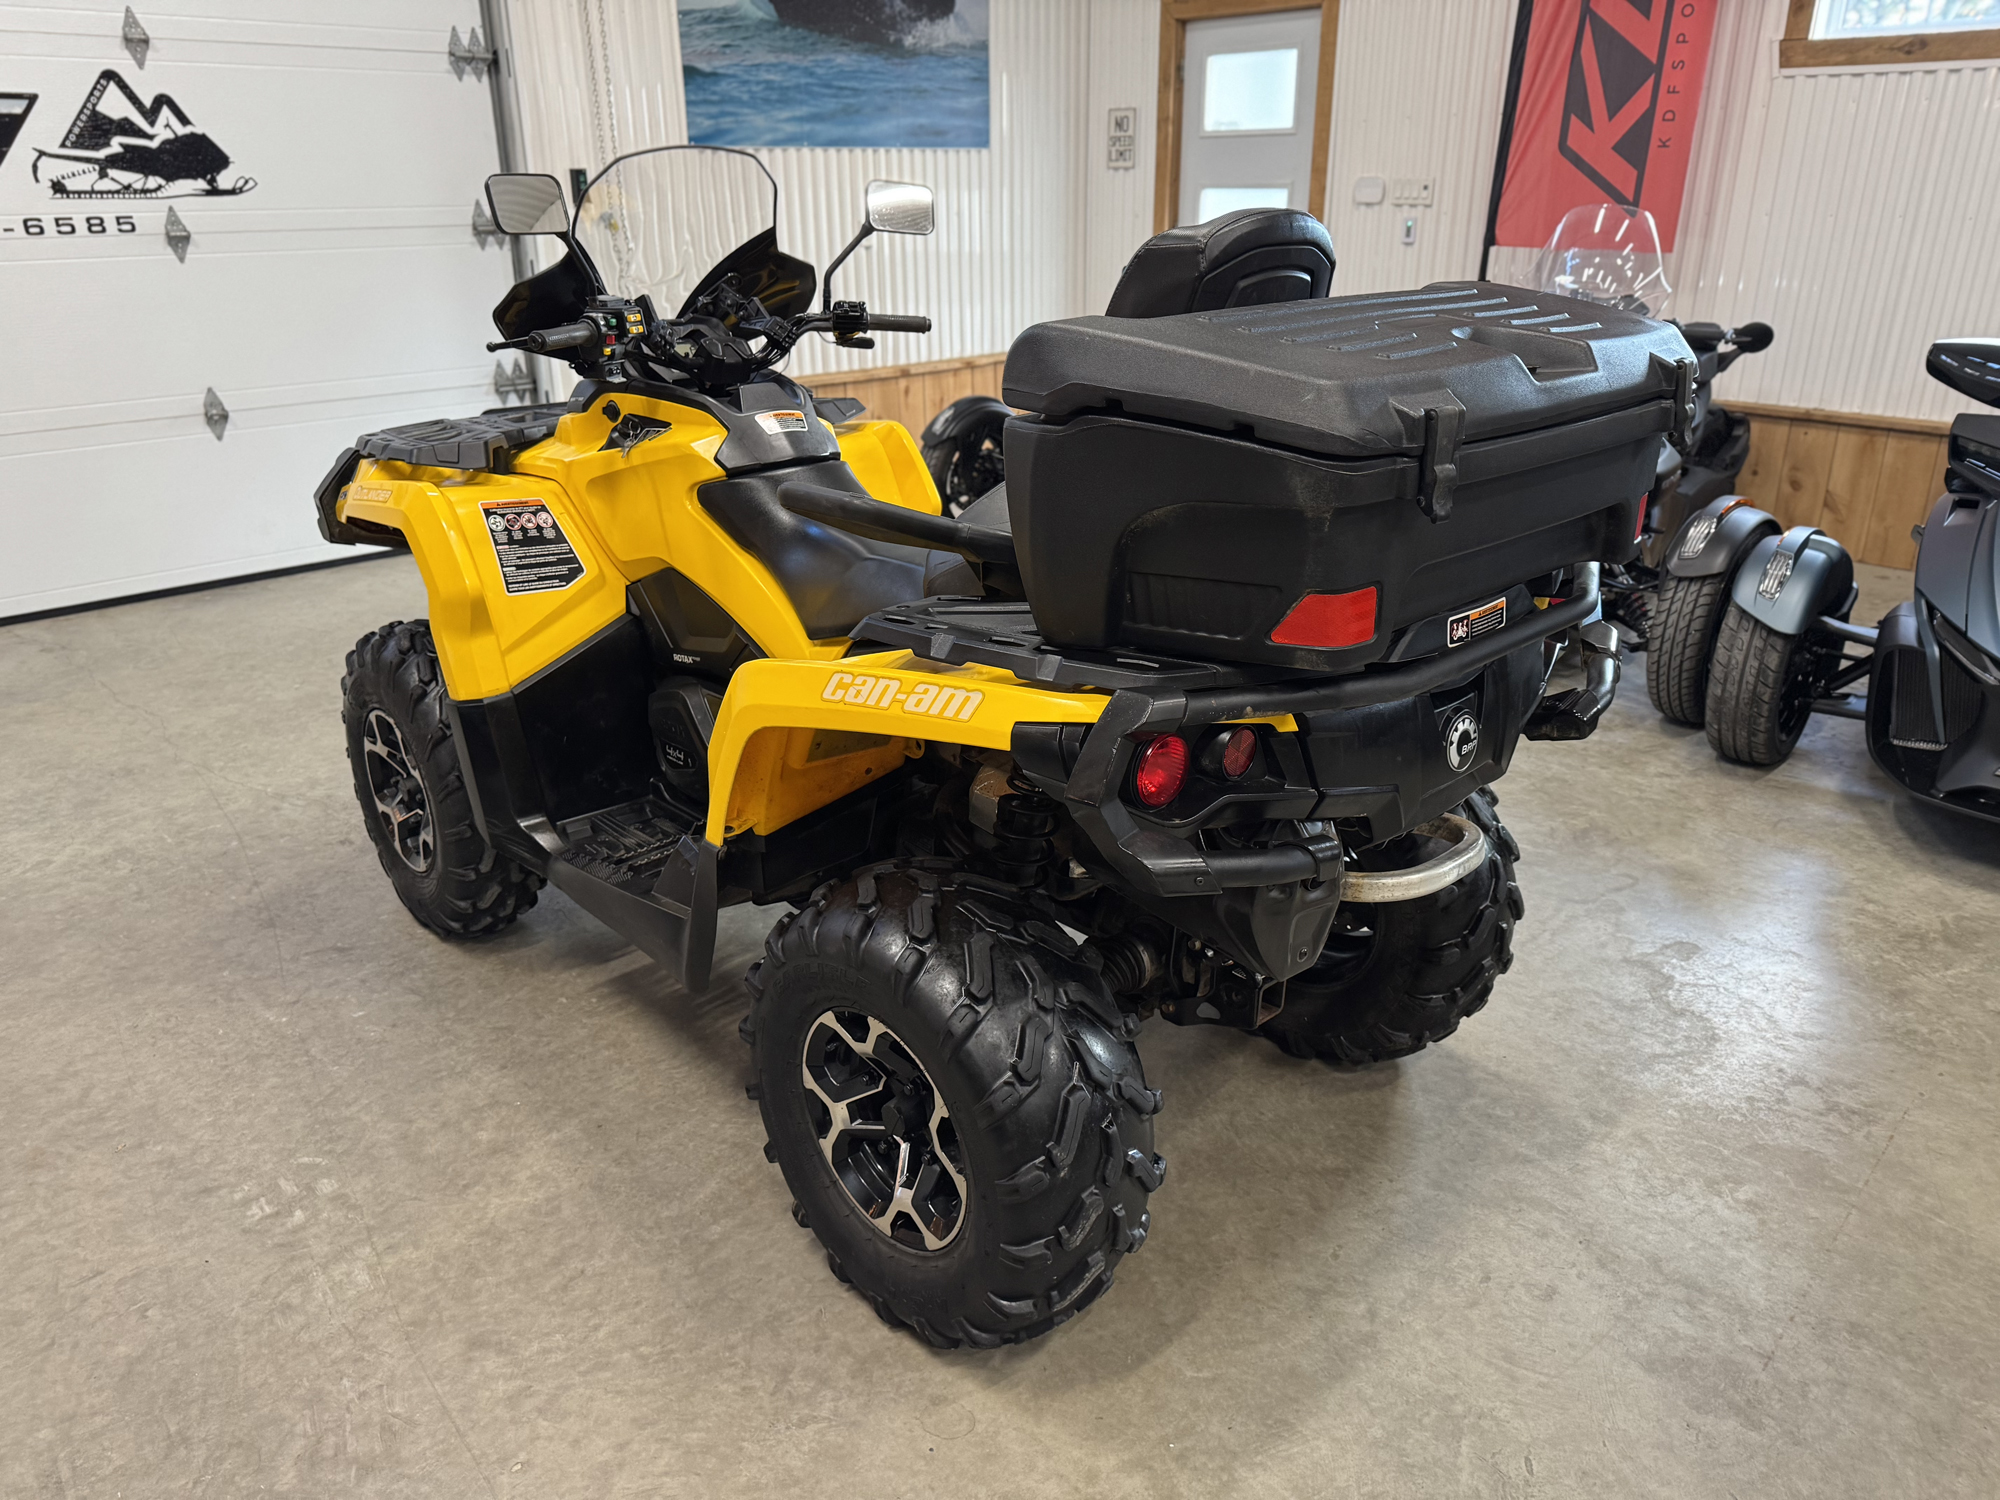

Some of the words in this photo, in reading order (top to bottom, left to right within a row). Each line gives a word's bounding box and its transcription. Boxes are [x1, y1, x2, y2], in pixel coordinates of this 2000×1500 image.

[1657, 3, 1695, 148] KDFSPO
[65, 78, 108, 147] POWERSPORTS
[1114, 115, 1130, 133] NO
[1109, 136, 1132, 147] SPEED
[1109, 149, 1131, 162] LIMIT
[2, 215, 137, 236] -6585
[673, 653, 694, 664] ROTAX
[822, 672, 984, 720] can-am
[1461, 740, 1477, 755] BRP
